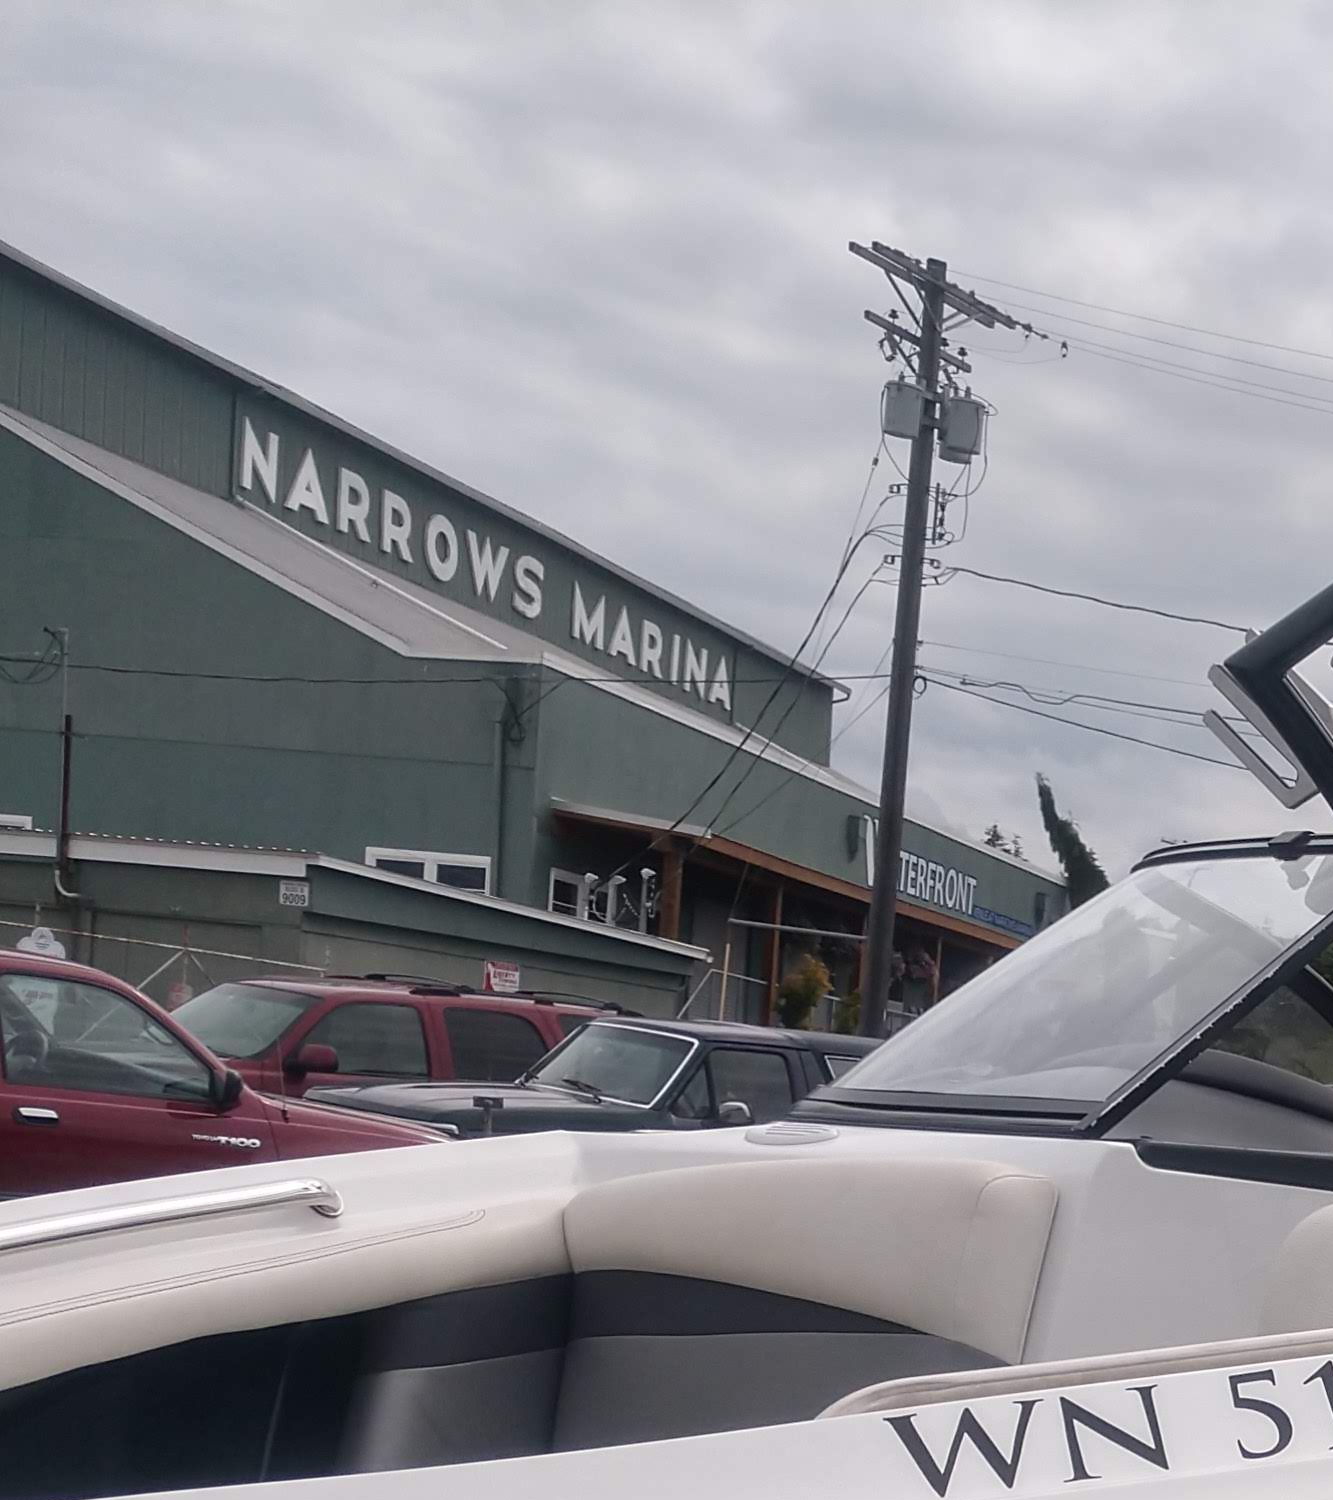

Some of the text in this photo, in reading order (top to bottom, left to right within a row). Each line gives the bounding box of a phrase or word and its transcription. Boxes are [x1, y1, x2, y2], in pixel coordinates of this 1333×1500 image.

[239, 416, 732, 711] NARROWS MARINA
[863, 814, 977, 915] TERFRONT
[883, 1384, 1170, 1498] WN
